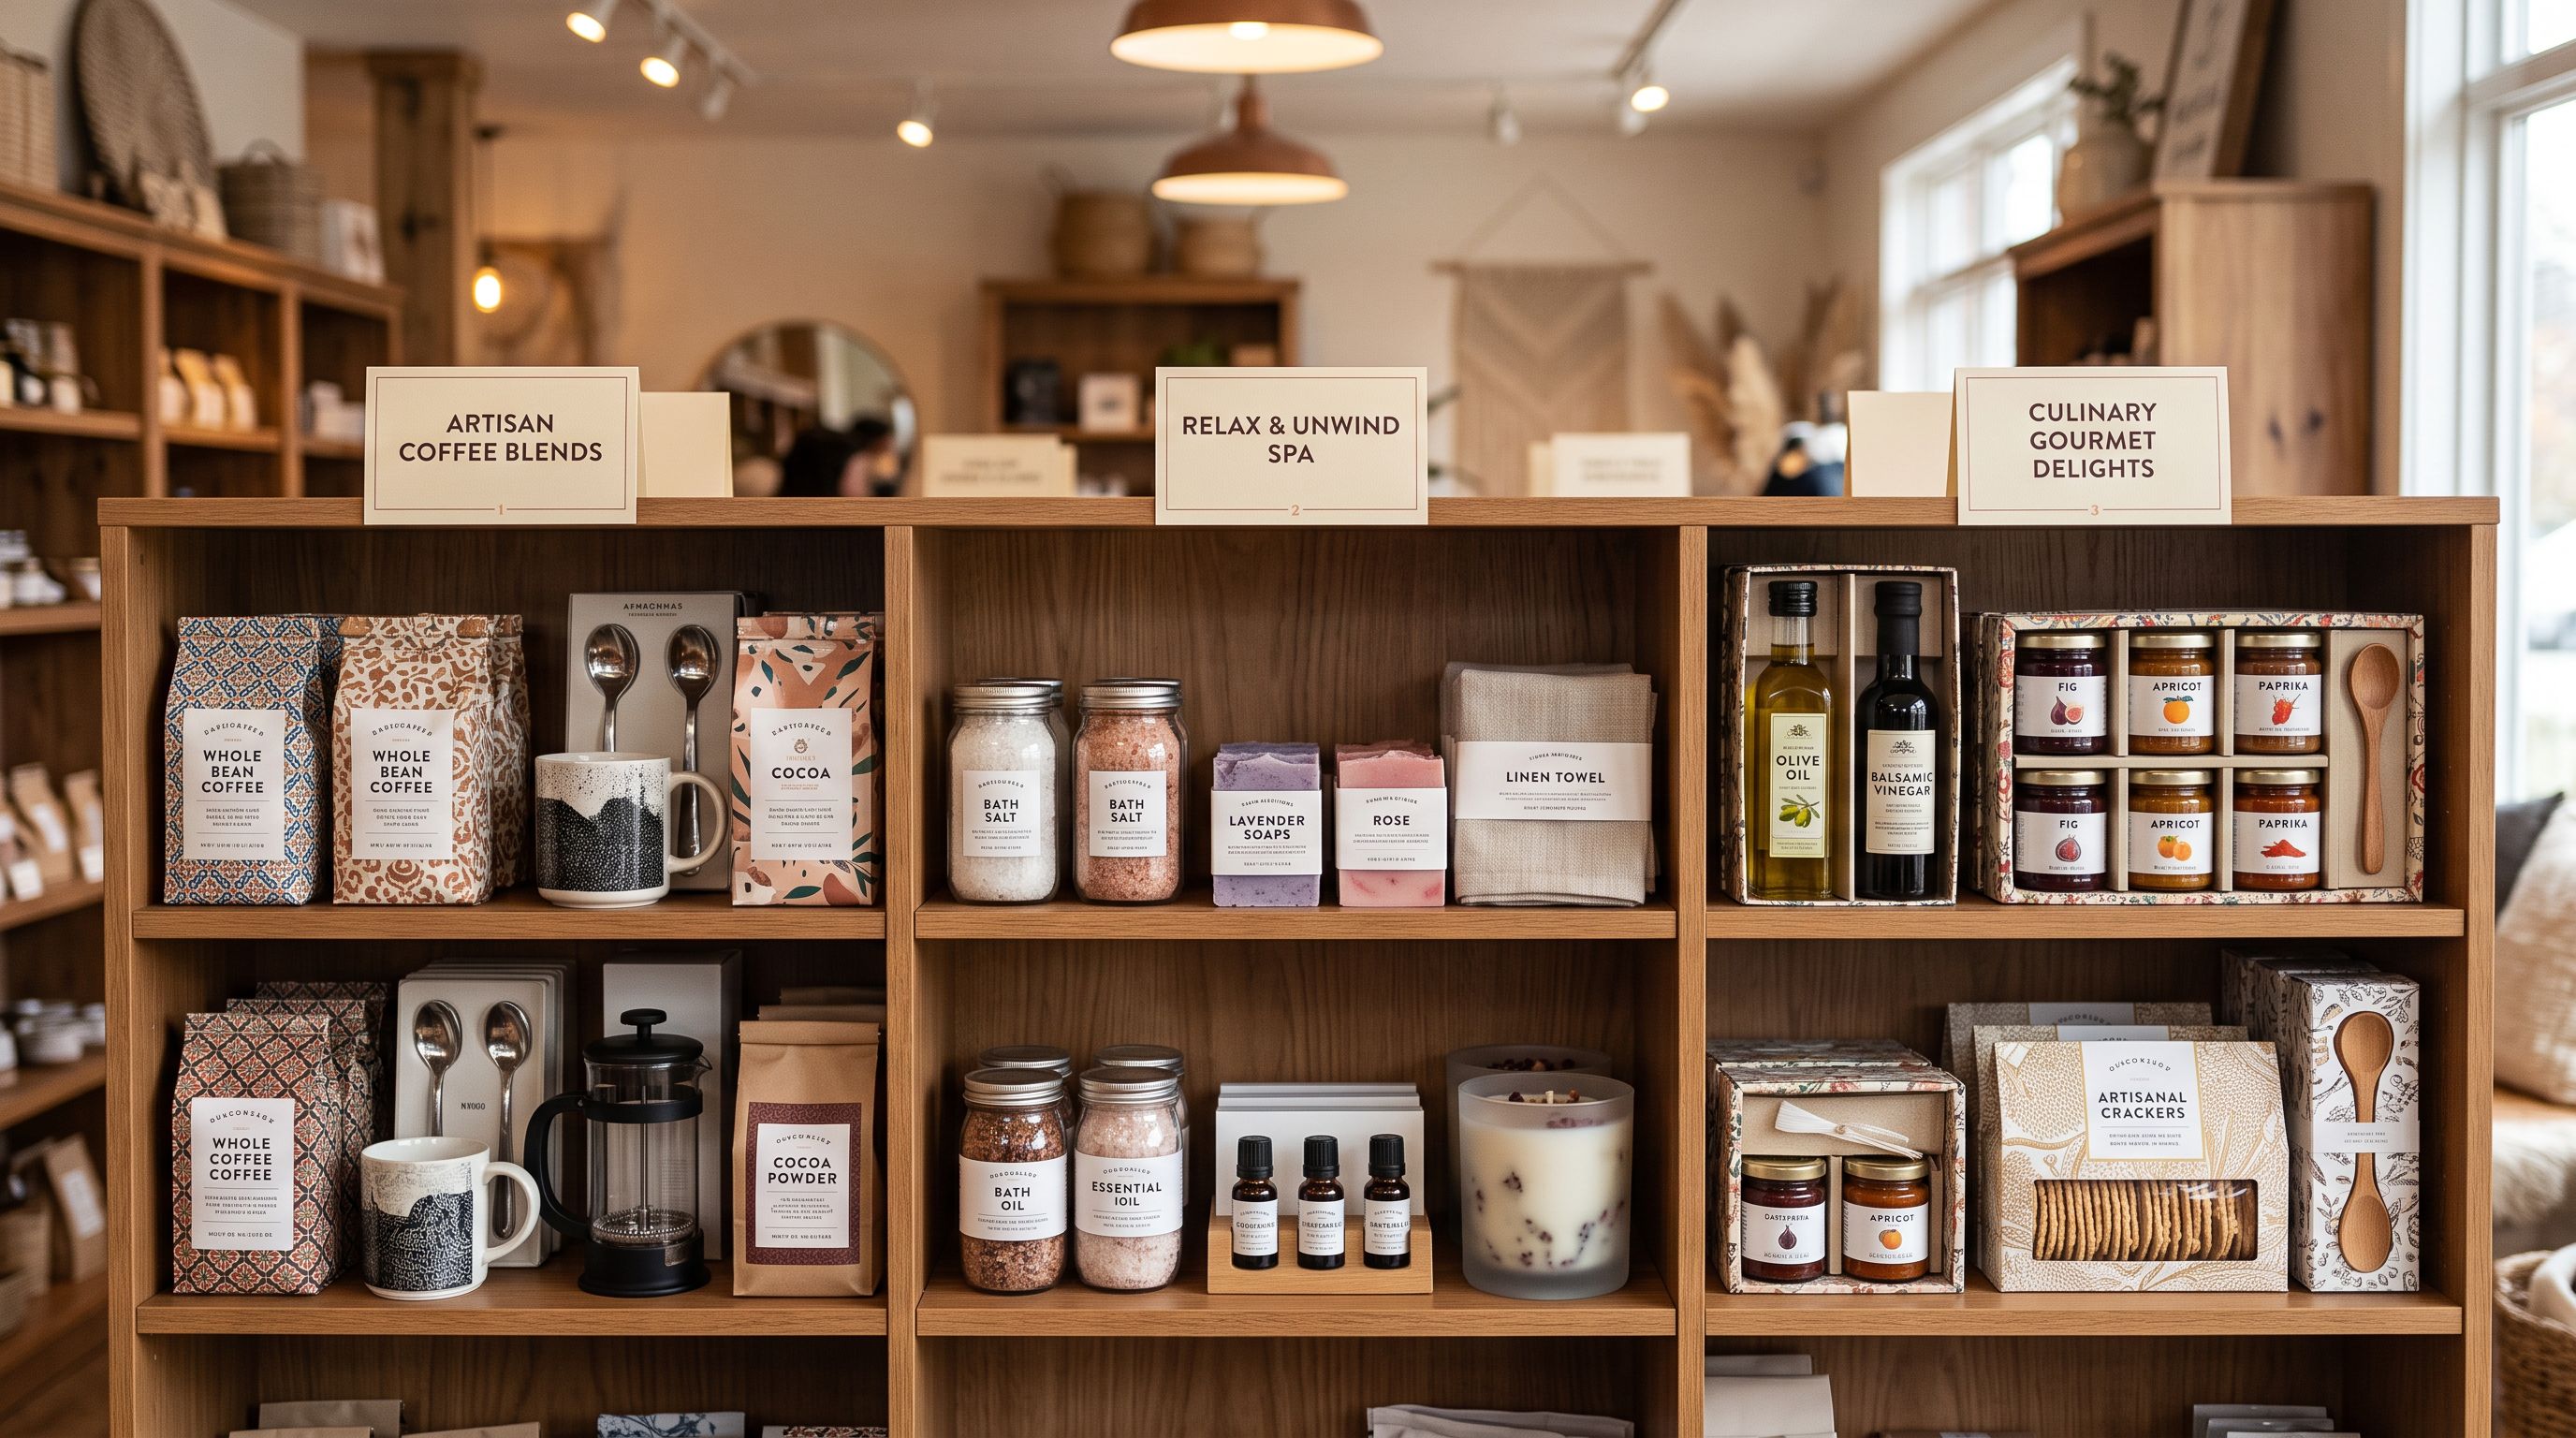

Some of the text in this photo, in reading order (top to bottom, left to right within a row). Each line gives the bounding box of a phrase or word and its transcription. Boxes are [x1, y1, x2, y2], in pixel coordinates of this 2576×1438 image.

[2029, 404, 2157, 421] CULINARY
[446, 414, 552, 433] ARTISAN
[1183, 416, 1399, 434] RELAX & UNWIND
[2030, 431, 2156, 449] GOURMET
[400, 443, 602, 462] COFFEE BLENDS
[1268, 445, 1314, 462] SPA
[2034, 459, 2154, 477] DELIGHTS
[499, 505, 503, 515] 1
[1292, 505, 1299, 516] 2
[2091, 505, 2099, 516] 3
[2059, 682, 2076, 691] FIG
[2153, 682, 2201, 691] APRICOT
[2259, 682, 2307, 690] PAPRIKA
[204, 750, 261, 761] WHOLE
[373, 751, 430, 762] WHOLE
[1777, 756, 1819, 766] OLIVE
[212, 766, 253, 777] BEAN
[381, 767, 422, 777] BEAN
[772, 768, 830, 779] COCOA
[1786, 770, 1809, 780] OIL
[1507, 772, 1604, 783] LINEN TOWEL
[1871, 771, 1933, 784] BALSAMIC
[202, 782, 263, 793] COFFEE
[371, 782, 432, 793] COFFEE
[1873, 785, 1931, 796] VINEGAR
[985, 800, 1017, 809] BATH
[1110, 800, 1143, 809] BATH
[986, 813, 1016, 822] SALT
[1111, 813, 1142, 822] SALT
[1230, 816, 1304, 826] LAVENDER
[1374, 815, 1410, 825] ROSE
[2060, 820, 2077, 829] FIG
[2151, 820, 2199, 829] APRICOT
[2260, 819, 2306, 828] PAPRIKA
[1244, 829, 1290, 840] SOAPS
[2099, 1092, 2187, 1103] ARTISANAL
[2101, 1108, 2185, 1118] CRACKERS
[212, 1138, 270, 1149] WHOLE
[210, 1153, 271, 1165] COFFEE
[774, 1157, 831, 1168] COCOA
[210, 1169, 271, 1181] COFFEE
[768, 1173, 837, 1183] POWDER
[995, 1187, 1030, 1196] BATH
[1092, 1181, 1162, 1193] ESSENTIAL
[1002, 1201, 1024, 1211] OIL
[1115, 1197, 1139, 1206] IOIL
